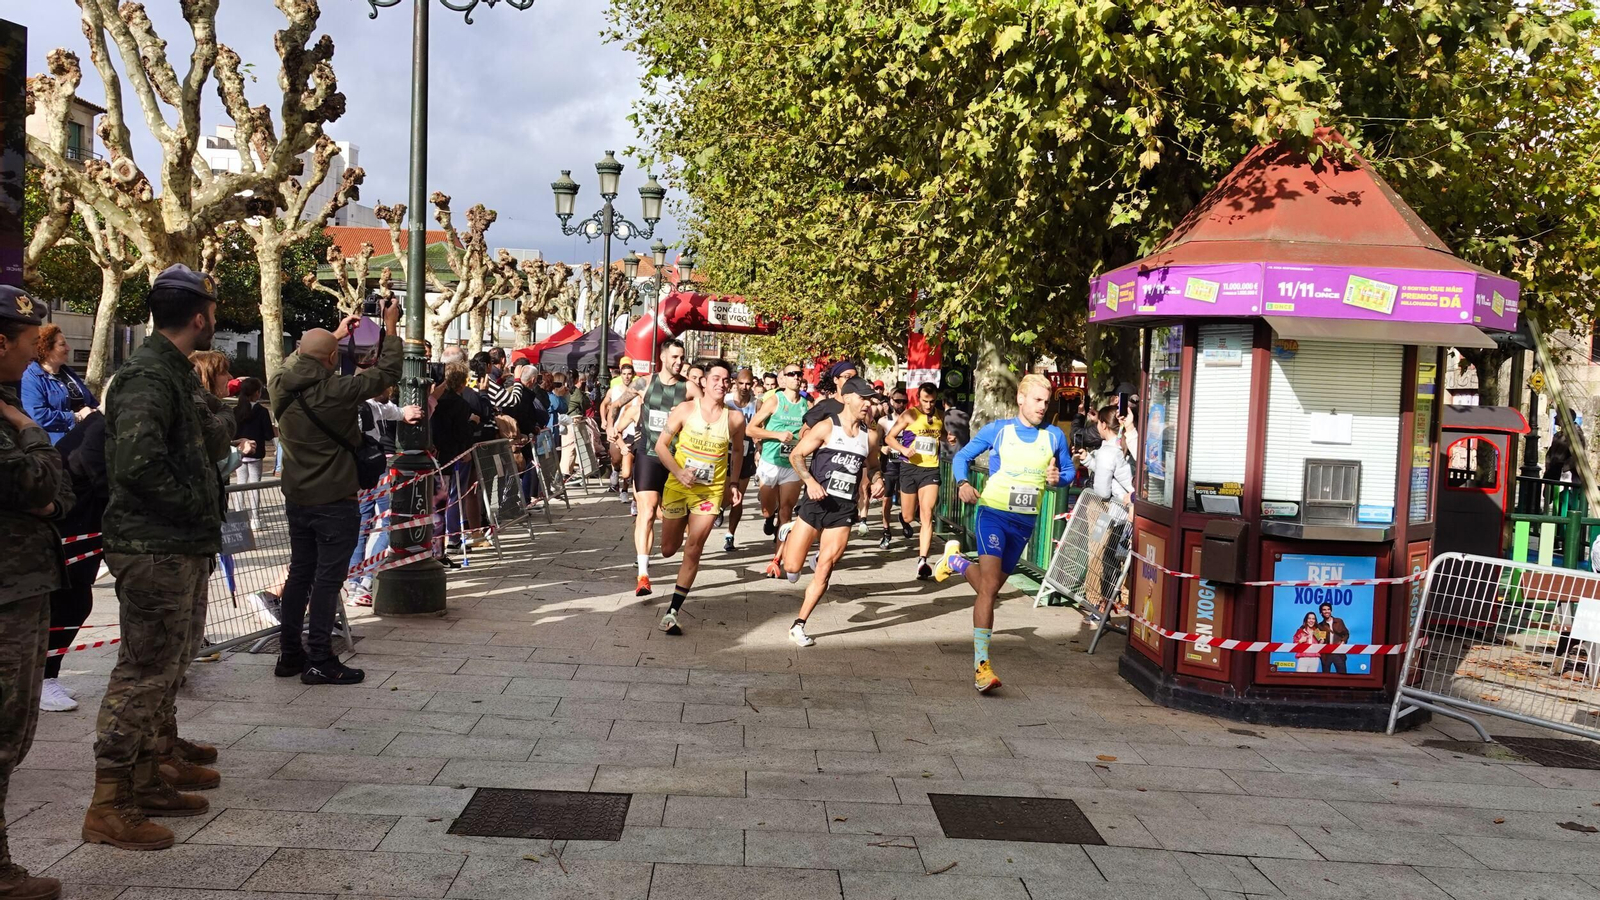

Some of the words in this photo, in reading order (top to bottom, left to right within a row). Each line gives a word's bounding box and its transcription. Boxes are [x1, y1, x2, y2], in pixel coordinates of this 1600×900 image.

[1278, 281, 1314, 300] 11/11
[1401, 292, 1438, 300] PREMIOS
[1439, 294, 1461, 308] DÁ
[920, 441, 931, 451] 771
[832, 479, 851, 492] 204
[1015, 493, 1033, 506] 681
[1307, 565, 1343, 588] BEN
[1294, 587, 1353, 606] XOGADO
[1194, 622, 1213, 653] BN
